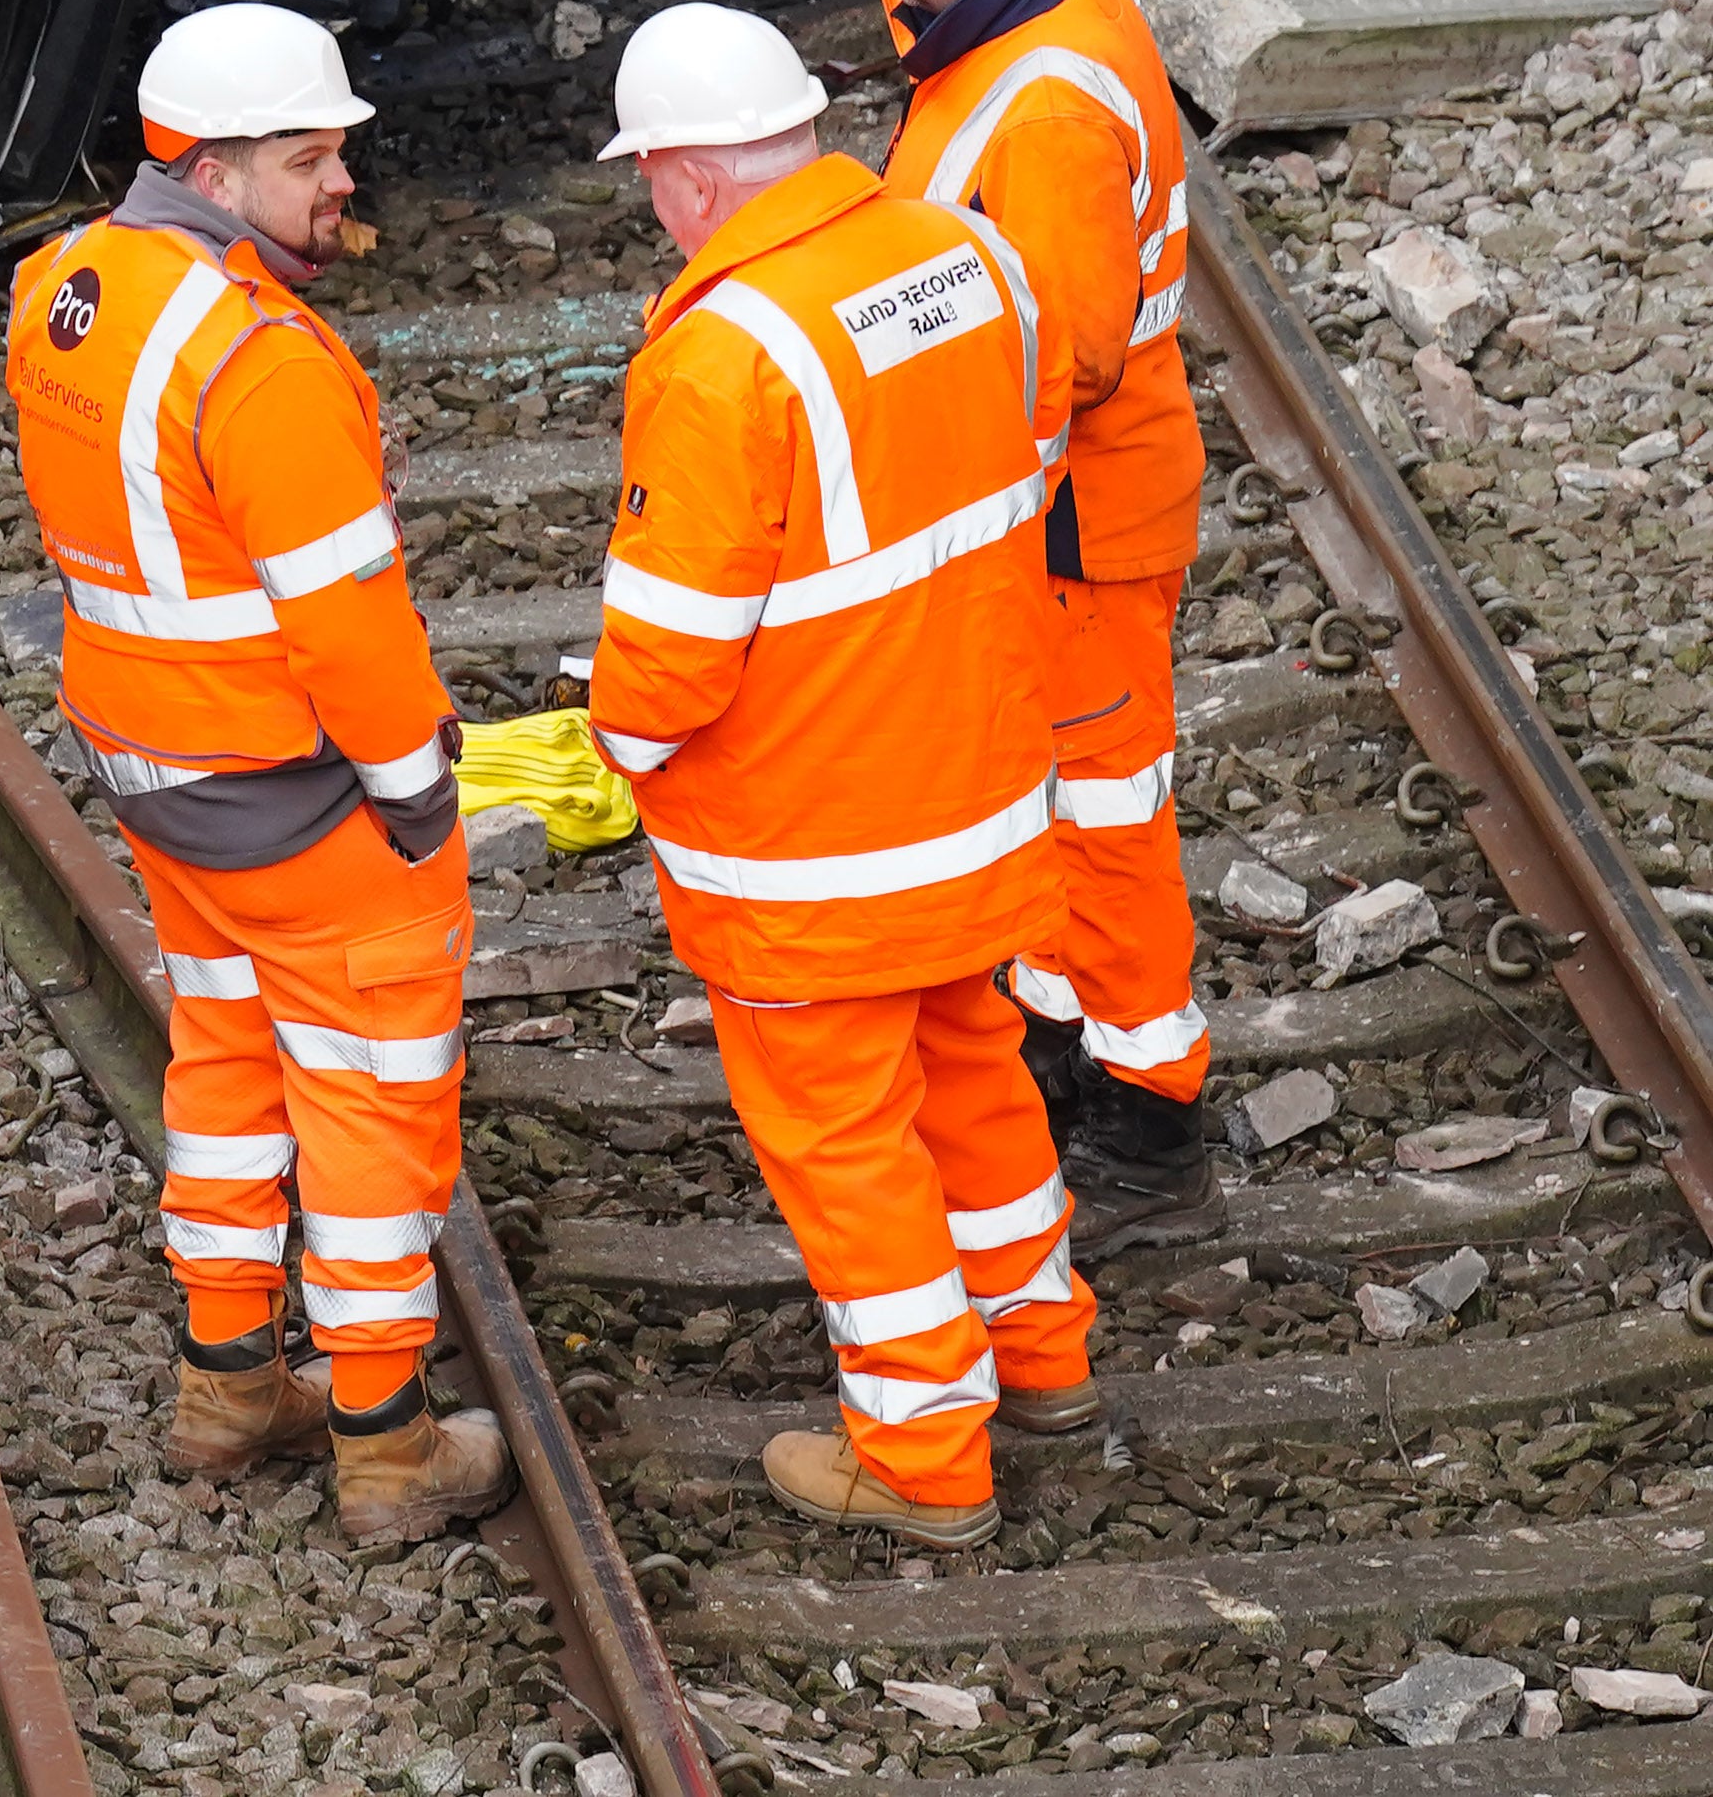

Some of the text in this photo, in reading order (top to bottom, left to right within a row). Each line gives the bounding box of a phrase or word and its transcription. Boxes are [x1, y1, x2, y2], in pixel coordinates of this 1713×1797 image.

[49, 281, 96, 337] Pro
[845, 256, 983, 333] LAND RECOVERY
[36, 368, 103, 423] Services
